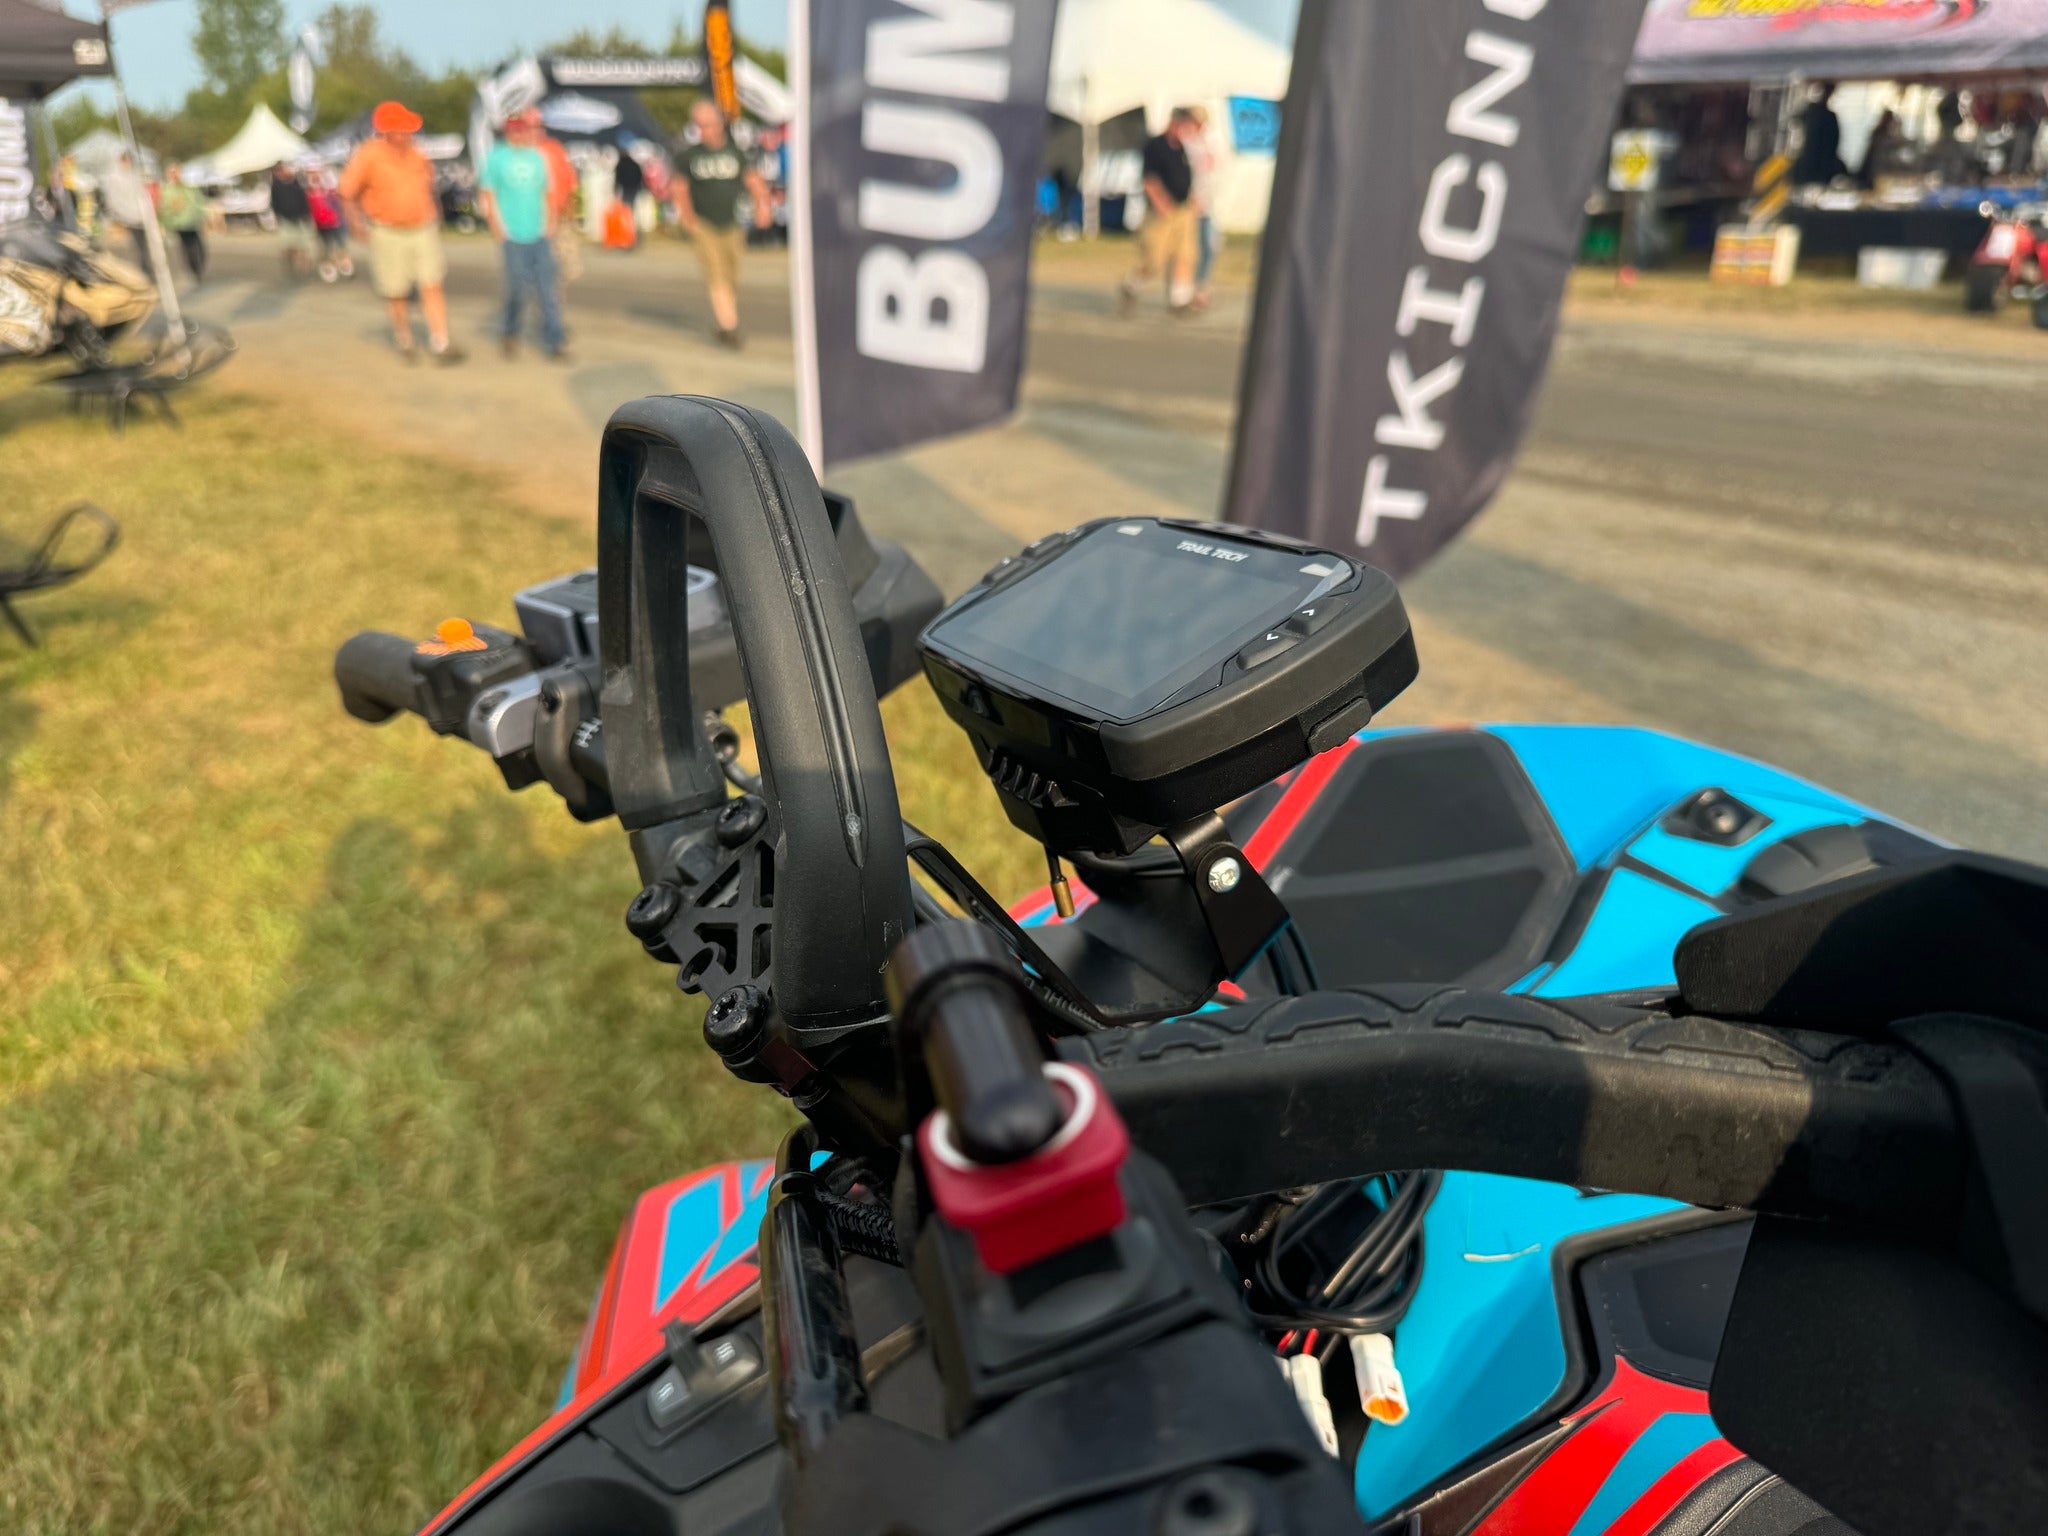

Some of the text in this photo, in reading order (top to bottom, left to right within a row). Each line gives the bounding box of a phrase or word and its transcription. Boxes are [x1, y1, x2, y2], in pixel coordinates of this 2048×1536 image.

[1355, 0, 1548, 547] TKICN
[1176, 540, 1249, 562] TRAIL TECH
